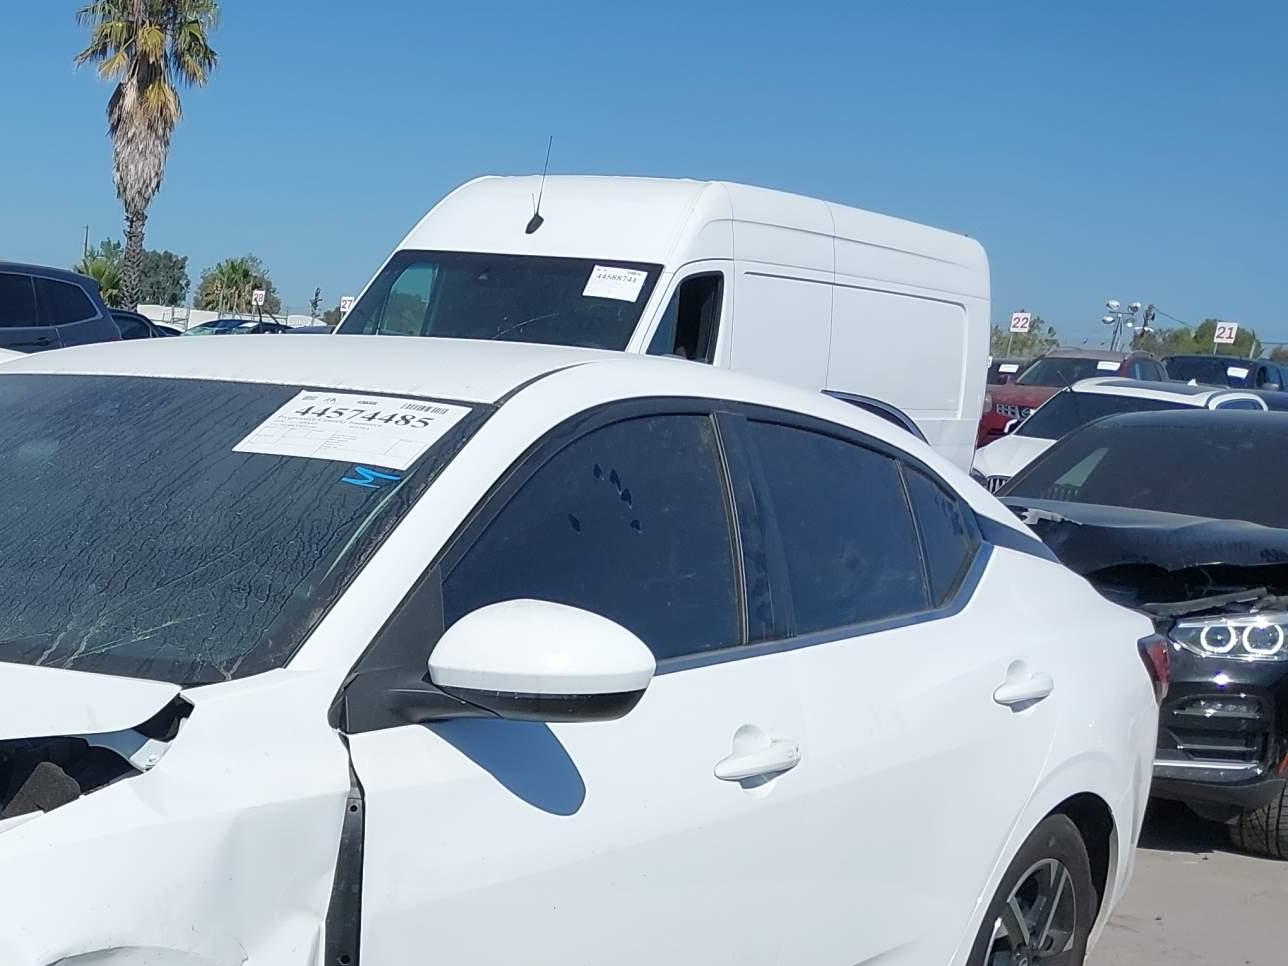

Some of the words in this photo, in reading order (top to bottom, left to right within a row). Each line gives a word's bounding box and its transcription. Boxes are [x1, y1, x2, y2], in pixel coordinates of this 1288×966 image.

[341, 299, 353, 309] 27
[1012, 316, 1029, 329] 22
[1216, 326, 1234, 339] 21
[295, 405, 434, 429] 44574485
